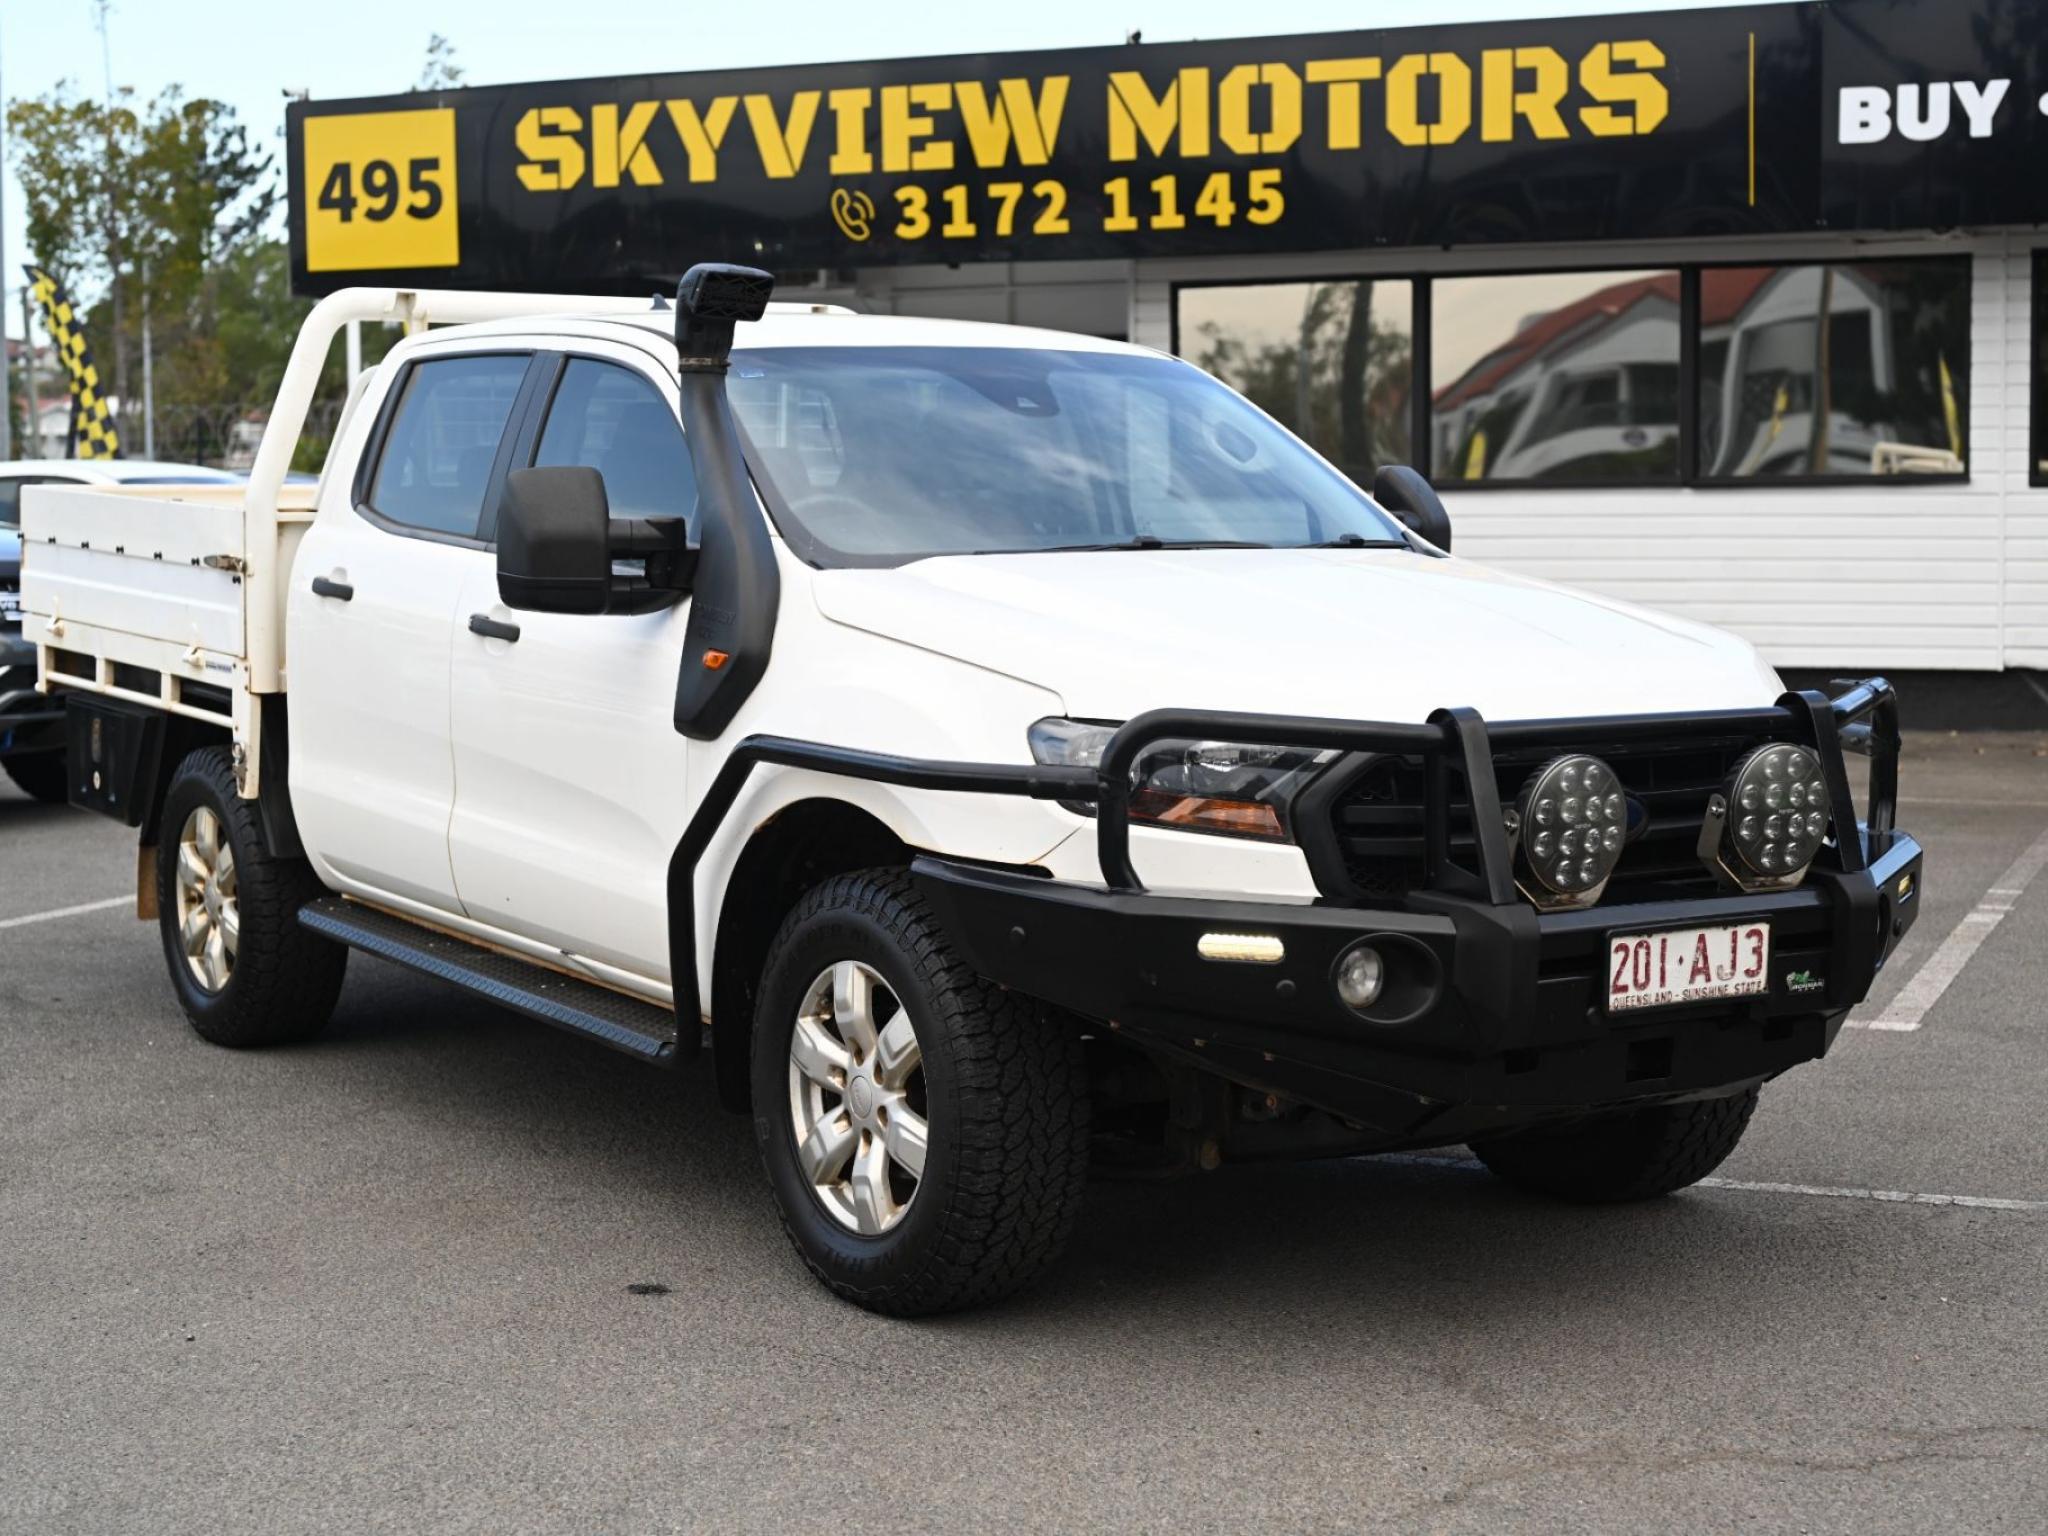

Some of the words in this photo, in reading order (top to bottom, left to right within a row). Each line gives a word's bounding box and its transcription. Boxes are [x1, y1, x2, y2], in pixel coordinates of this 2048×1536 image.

[516, 76, 1070, 190] SKYVIEW
[1108, 41, 1669, 160] MOTORS
[1839, 79, 2011, 144] BUY
[318, 157, 443, 222] 495
[895, 181, 1070, 239] 3172
[1104, 169, 1284, 231] 1145
[1734, 980, 1762, 994] STATE
